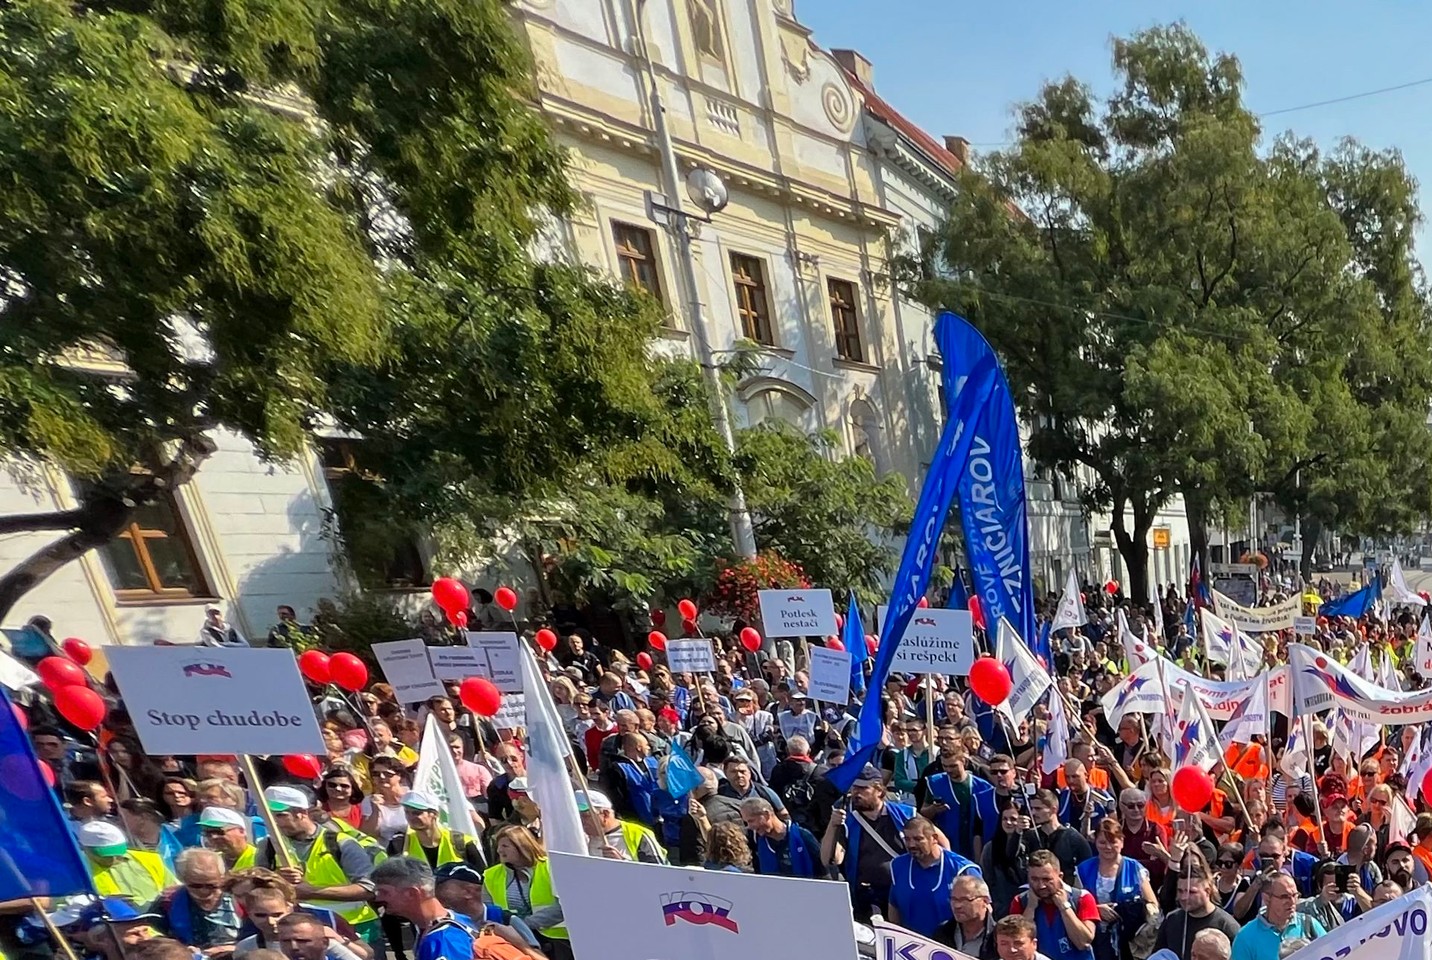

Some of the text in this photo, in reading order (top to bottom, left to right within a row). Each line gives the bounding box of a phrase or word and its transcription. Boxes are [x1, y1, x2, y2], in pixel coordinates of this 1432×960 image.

[781, 609, 818, 619] Potlesk
[783, 618, 819, 629] nestačí
[897, 651, 957, 665] si rešpekt
[147, 709, 302, 731] Stop chudobe
